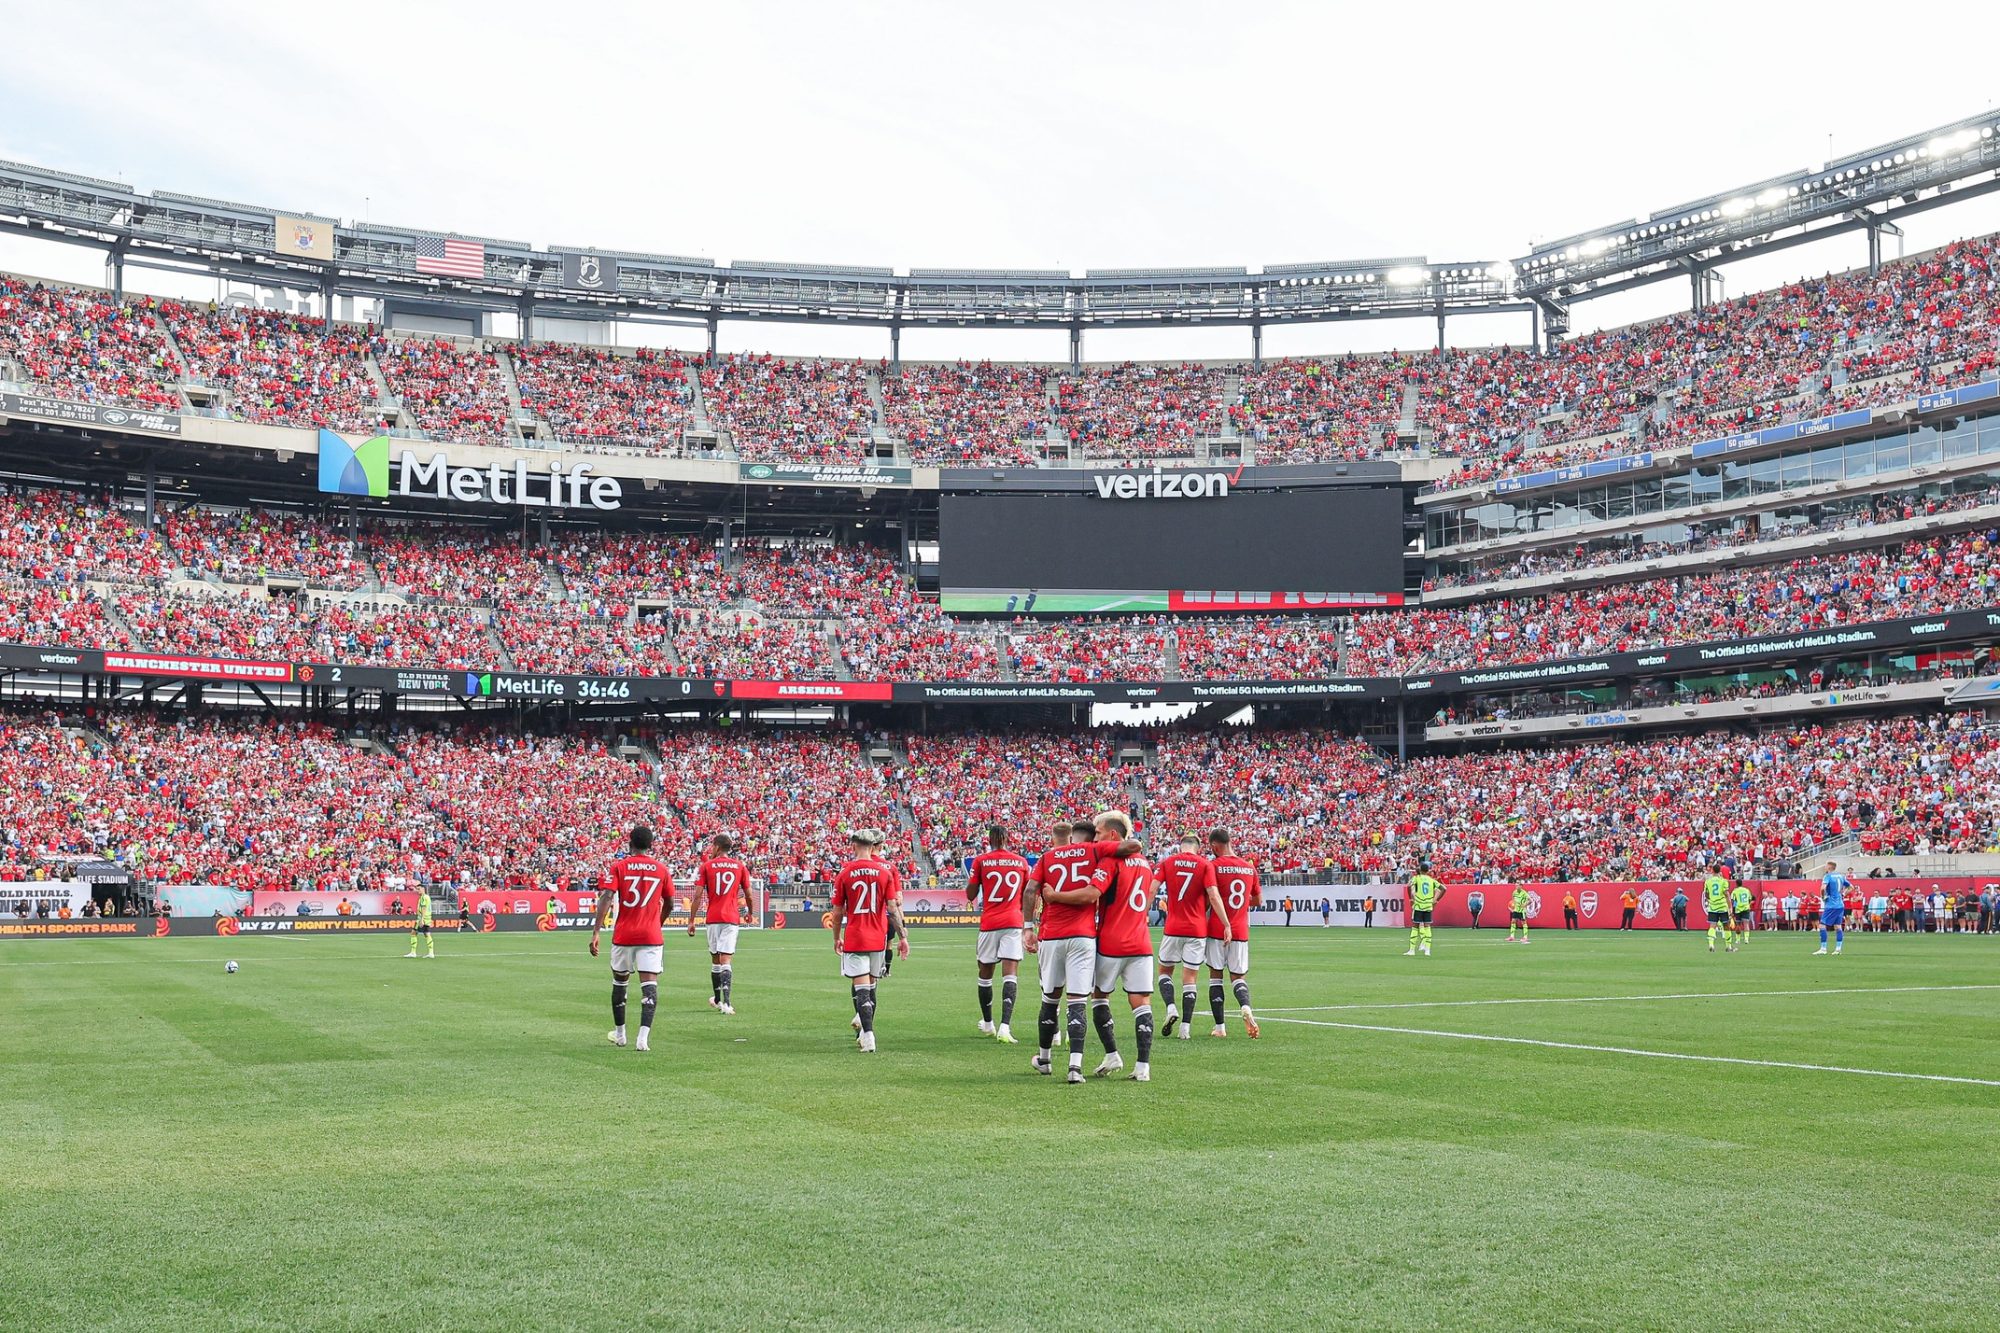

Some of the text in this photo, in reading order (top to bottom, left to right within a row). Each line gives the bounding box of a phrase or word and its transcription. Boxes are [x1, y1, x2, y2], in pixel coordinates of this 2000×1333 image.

[18, 397, 36, 406] Text
[73, 405, 96, 414] 78247
[29, 407, 43, 415] call
[45, 408, 96, 421] 201.559.1515
[130, 413, 165, 424] FANS
[140, 422, 180, 432] FIRST
[1728, 440, 1737, 448] 50
[776, 465, 821, 474] SUPER
[823, 466, 858, 475] BOWL
[400, 450, 622, 510] MetLife
[812, 474, 895, 483] CHAMPIONS
[1094, 467, 1229, 499] verizon
[1910, 623, 1945, 635] verizon
[1700, 631, 1876, 660] The Official 5G Network of MetLife Stadium.
[40, 654, 78, 665] verizon
[1637, 655, 1666, 667] verizon
[107, 656, 285, 677] MANCHESTER UNITED
[331, 668, 341, 681] 2
[398, 672, 451, 682] OLD RIVALS.
[1460, 662, 1609, 685] The Official 5G Network of MetLife Stadium.
[398, 679, 451, 691] NEW YORK.
[497, 677, 630, 698] MetLife 36:46
[681, 681, 691, 694] 0
[778, 685, 843, 695] ARSENAL
[1193, 684, 1365, 695] The Official 5G Network of MetLife Stadium.
[1407, 680, 1432, 690] verizon
[925, 687, 1095, 697] The Official 5G Network of MetLife Stadium.
[1126, 688, 1157, 696] verizon
[1842, 692, 1874, 702] MetLife
[1585, 714, 1626, 726] HCLTech
[1472, 726, 1501, 736] verizon
[1054, 848, 1086, 859] SANCHO
[627, 863, 657, 872] MAINOO
[1174, 859, 1198, 869] MOUNT
[850, 868, 880, 878] ANTONY
[1048, 860, 1092, 893] 25
[98, 875, 129, 884] STADIUM
[715, 871, 736, 896] 19
[623, 875, 661, 908] 37
[986, 870, 1022, 903] 29
[1175, 871, 1194, 902] 7
[1422, 882, 1429, 895] 6
[1712, 883, 1720, 896] 2
[25, 890, 74, 898] RIVALS.
[851, 880, 878, 915] 21
[1129, 875, 1147, 912] 6
[1228, 878, 1246, 910] 8
[260, 921, 276, 930] 27
[276, 921, 293, 930] AT
[294, 921, 343, 930] DIGNITY
[343, 920, 388, 929] HEALTH
[579, 917, 590, 927] 27
[923, 916, 958, 925] HEALTH
[0, 923, 136, 935] HEALTH SPORTS PARK
